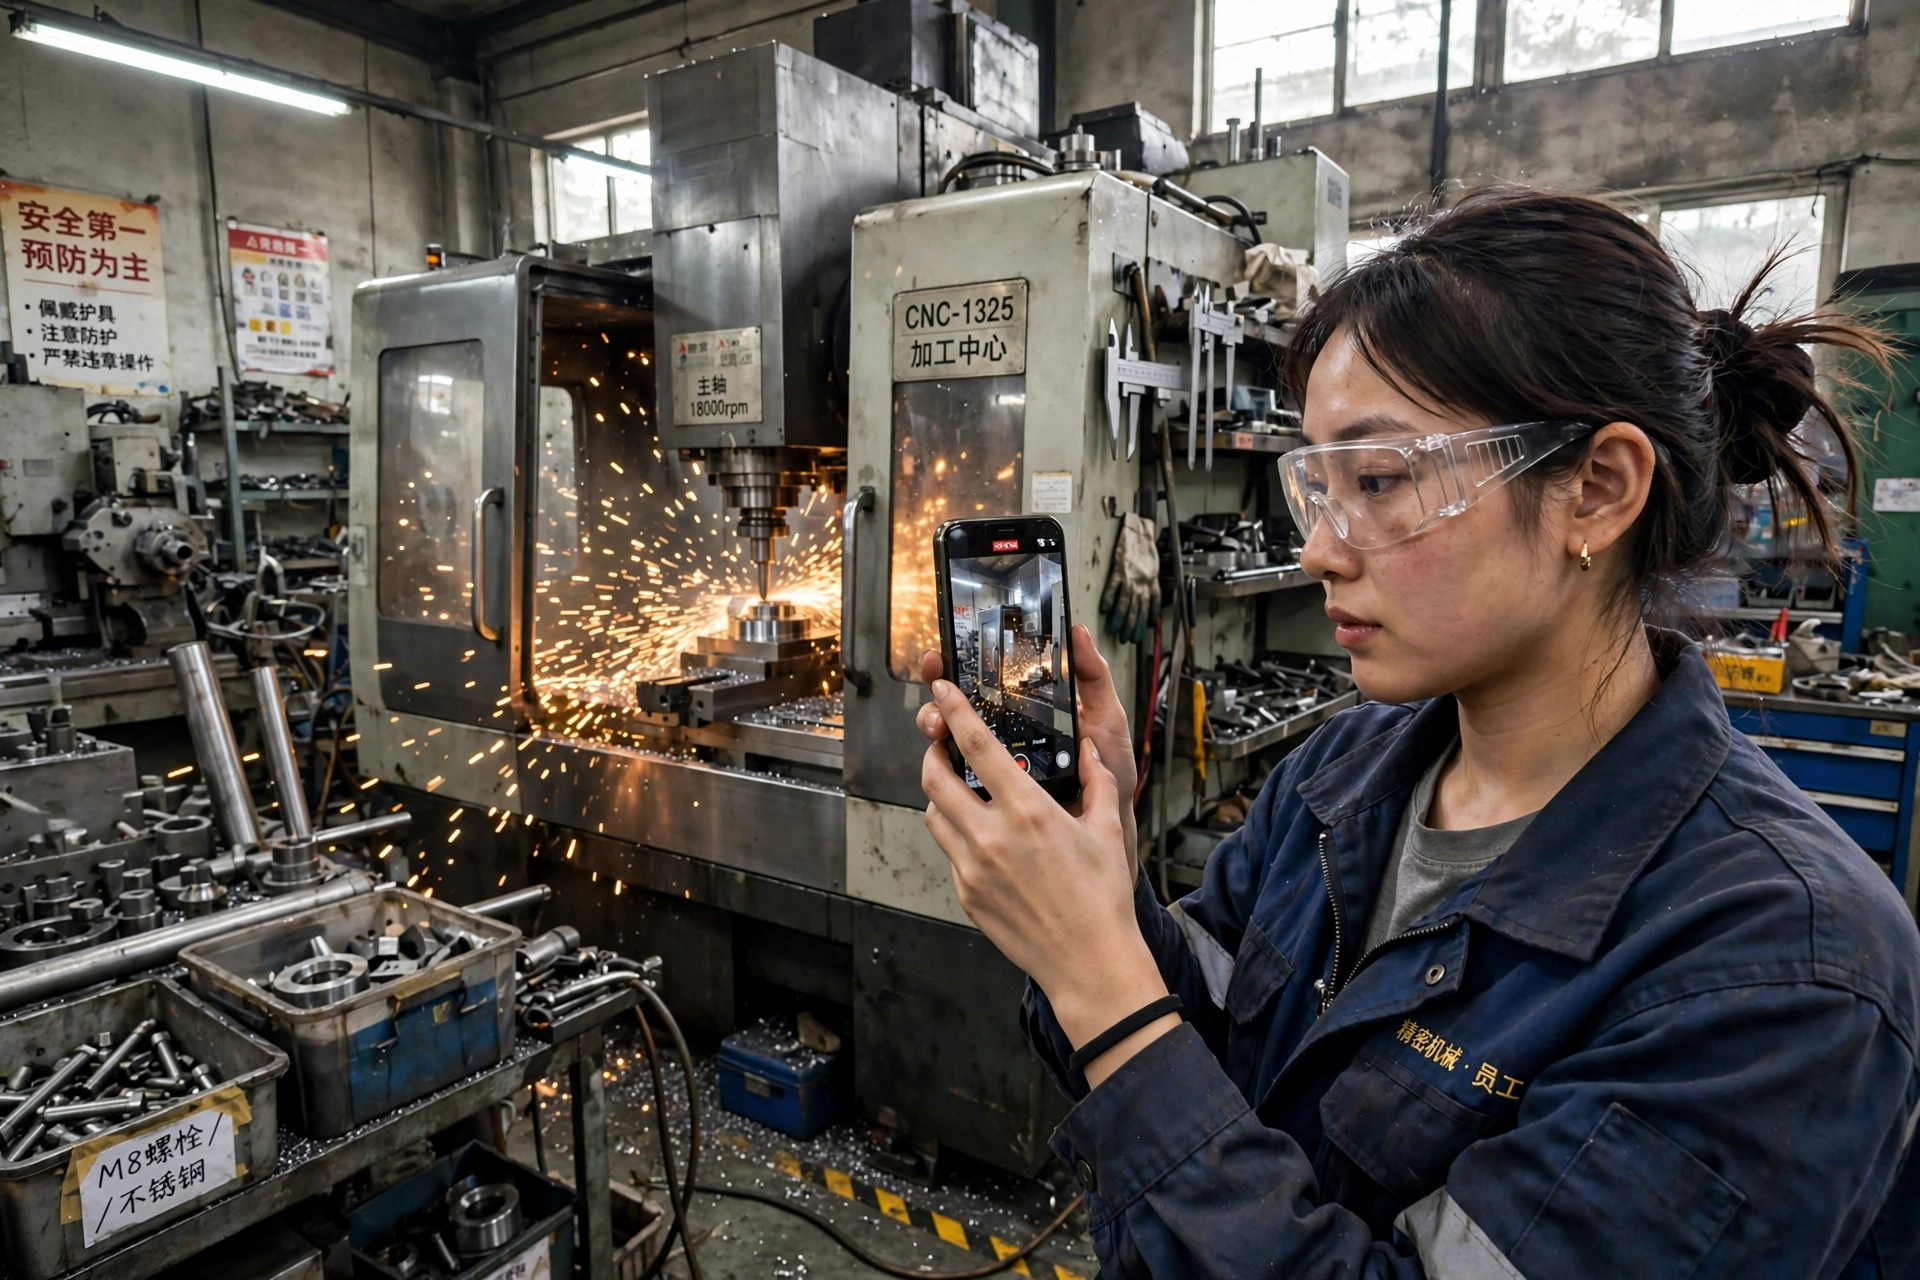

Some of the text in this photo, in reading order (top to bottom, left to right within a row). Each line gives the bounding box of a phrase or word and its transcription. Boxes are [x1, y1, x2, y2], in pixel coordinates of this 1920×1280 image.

[18, 200, 146, 241] 安全第一
[21, 238, 150, 282] 预防为主
[905, 295, 1014, 329] CNC-1325
[41, 323, 117, 345] 注意防护
[42, 348, 154, 372] 严禁违章操作
[910, 334, 1007, 368] 加工中心
[697, 374, 727, 396] 主轴
[690, 400, 748, 419] 18000rpm
